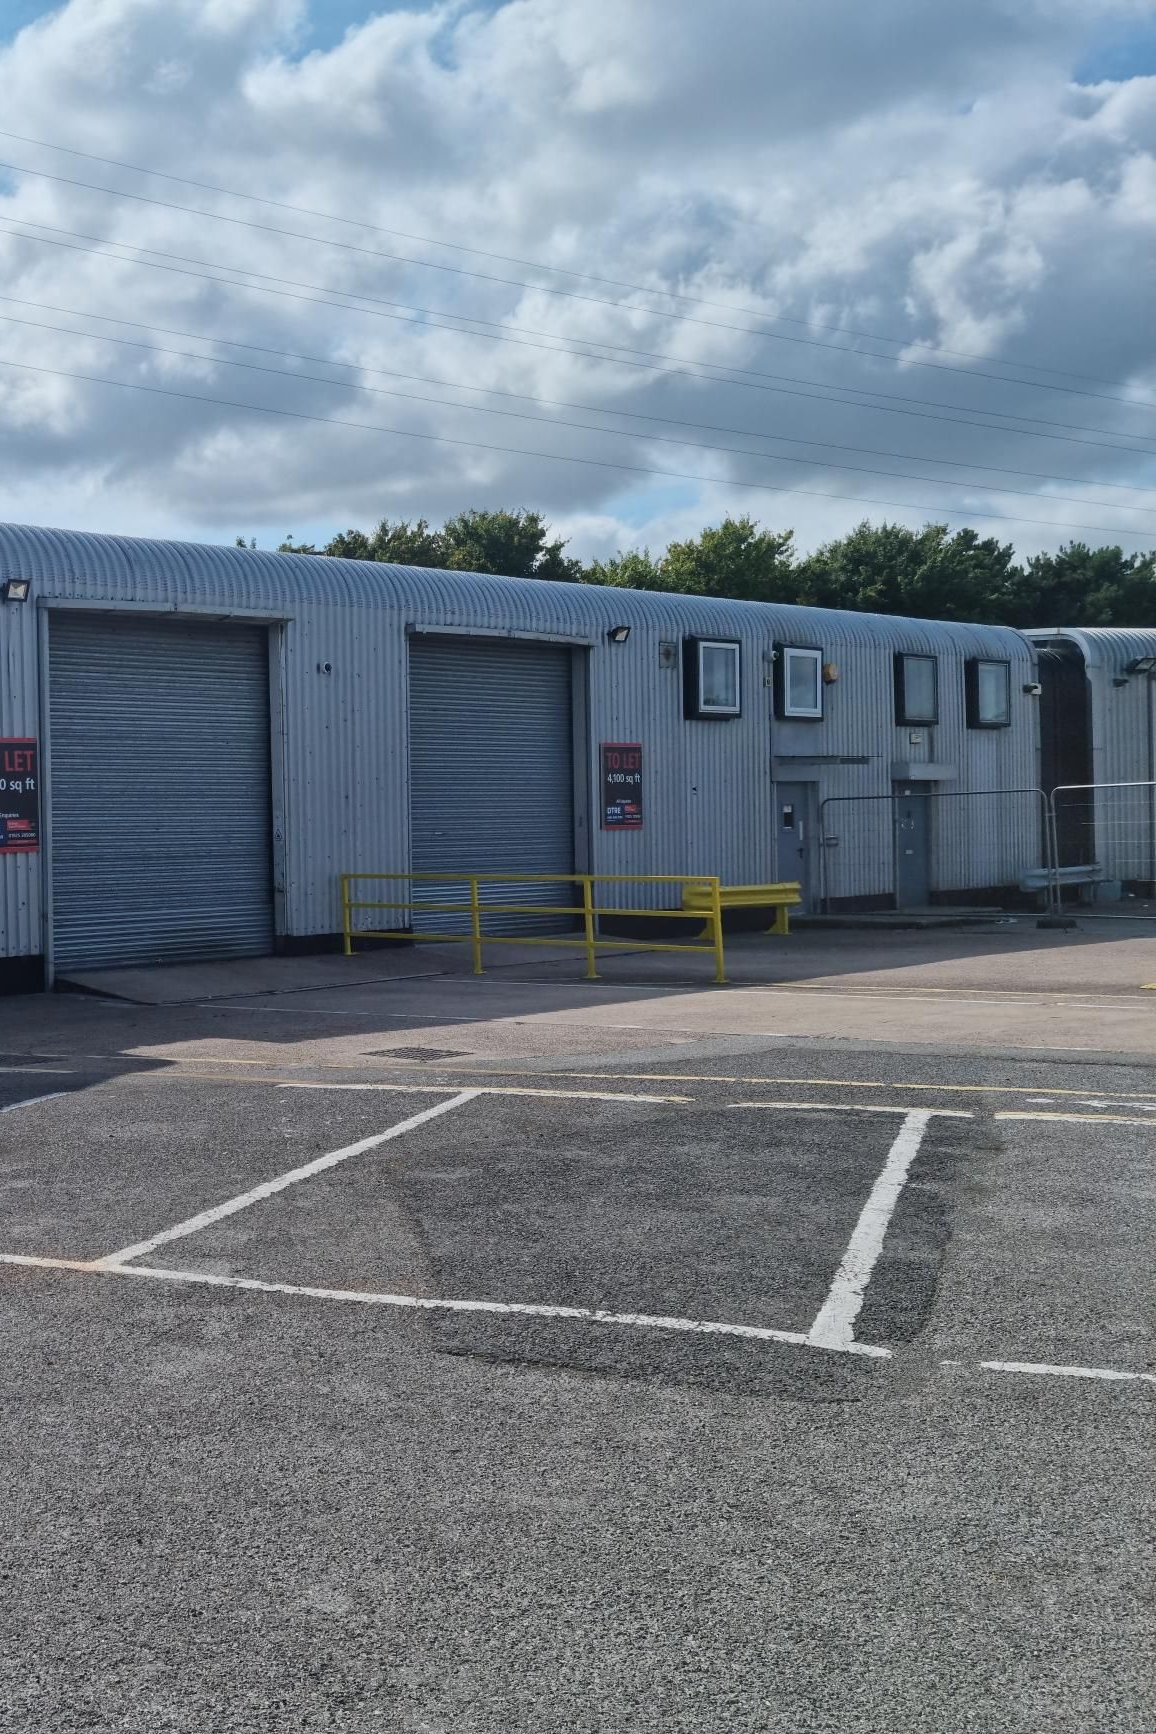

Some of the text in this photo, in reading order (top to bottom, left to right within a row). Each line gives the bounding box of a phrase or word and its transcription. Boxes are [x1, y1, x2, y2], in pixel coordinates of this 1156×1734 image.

[4, 750, 34, 772] LET
[606, 752, 640, 769] TO LET
[10, 781, 22, 793] sq
[25, 778, 35, 790] ft
[607, 773, 641, 785] 4,100 sq ft
